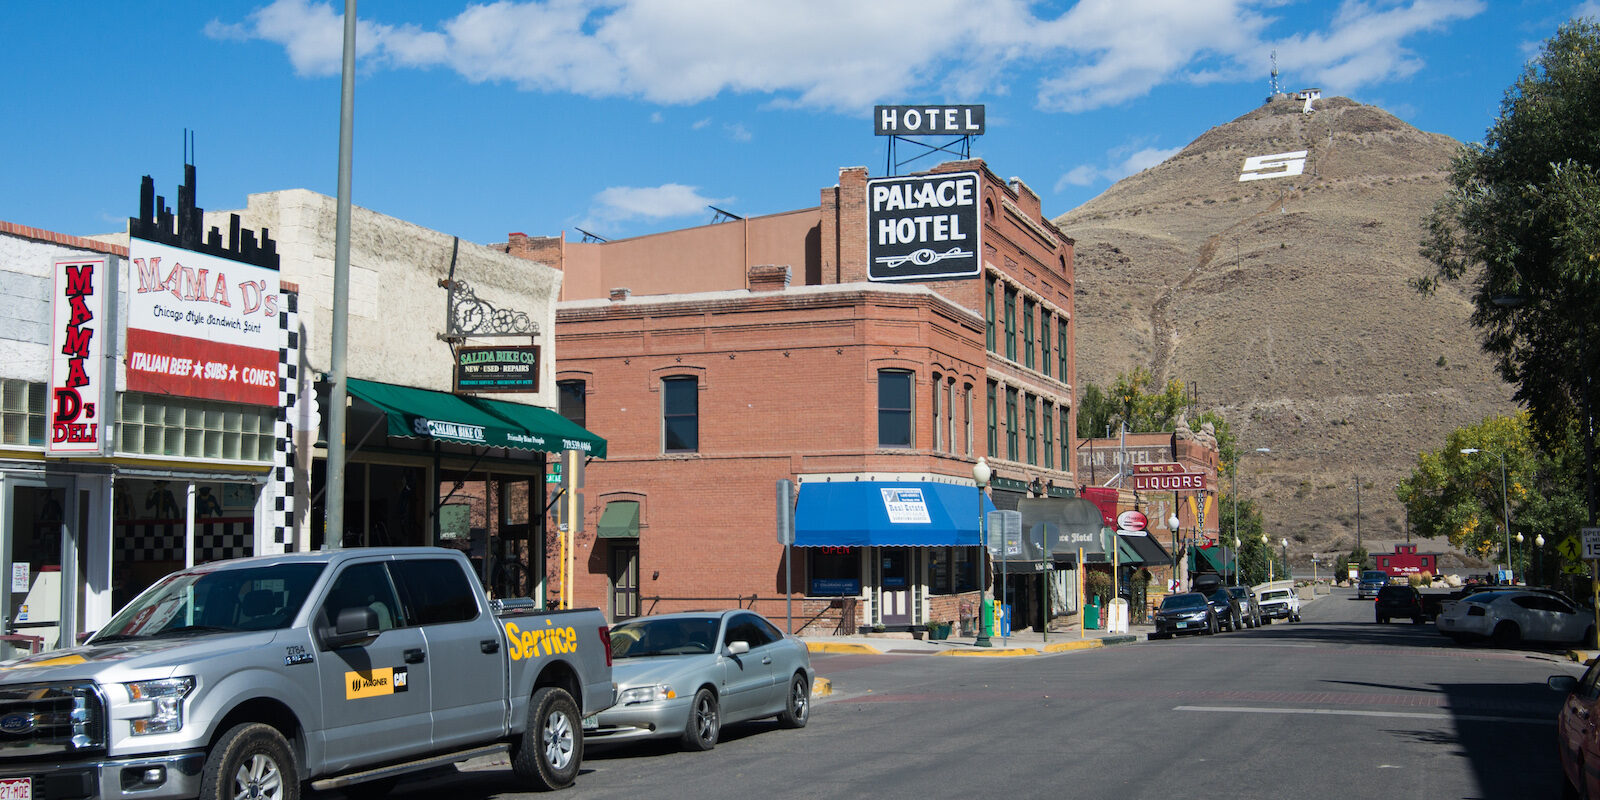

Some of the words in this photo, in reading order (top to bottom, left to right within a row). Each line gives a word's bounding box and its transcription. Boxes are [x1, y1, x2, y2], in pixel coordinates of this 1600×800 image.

[881, 109, 979, 130] HOTEL
[1239, 150, 1308, 182] S
[873, 179, 973, 212] PALACE
[878, 214, 967, 245] HOTEL
[133, 256, 231, 307] MAMA
[239, 279, 278, 317] D's
[61, 264, 94, 388] MAMA
[153, 304, 184, 322] Chicago
[185, 310, 205, 325] Style
[206, 314, 241, 330] Sandwich
[243, 320, 261, 333] Joint
[460, 351, 495, 365] SALIDA
[496, 351, 519, 363] BIKE
[131, 351, 170, 375] ITALIAN
[169, 357, 193, 376] BEEF
[203, 361, 228, 381] SUBS
[242, 366, 277, 388] CONES
[465, 365, 480, 373] NEW
[503, 365, 529, 373] REPAIRS
[53, 423, 97, 443] DELI
[434, 422, 458, 437] SALIDA
[458, 426, 474, 438] BIKE
[1077, 452, 1106, 467] TAN
[1136, 475, 1202, 489] LIQUORS
[1071, 532, 1093, 543] Hotel
[822, 546, 851, 554] OPEN
[1587, 543, 1600, 556] 15
[505, 619, 578, 661] Service
[286, 646, 305, 655] 2784
[363, 678, 387, 688] WAGNER
[393, 672, 408, 687] CAT
